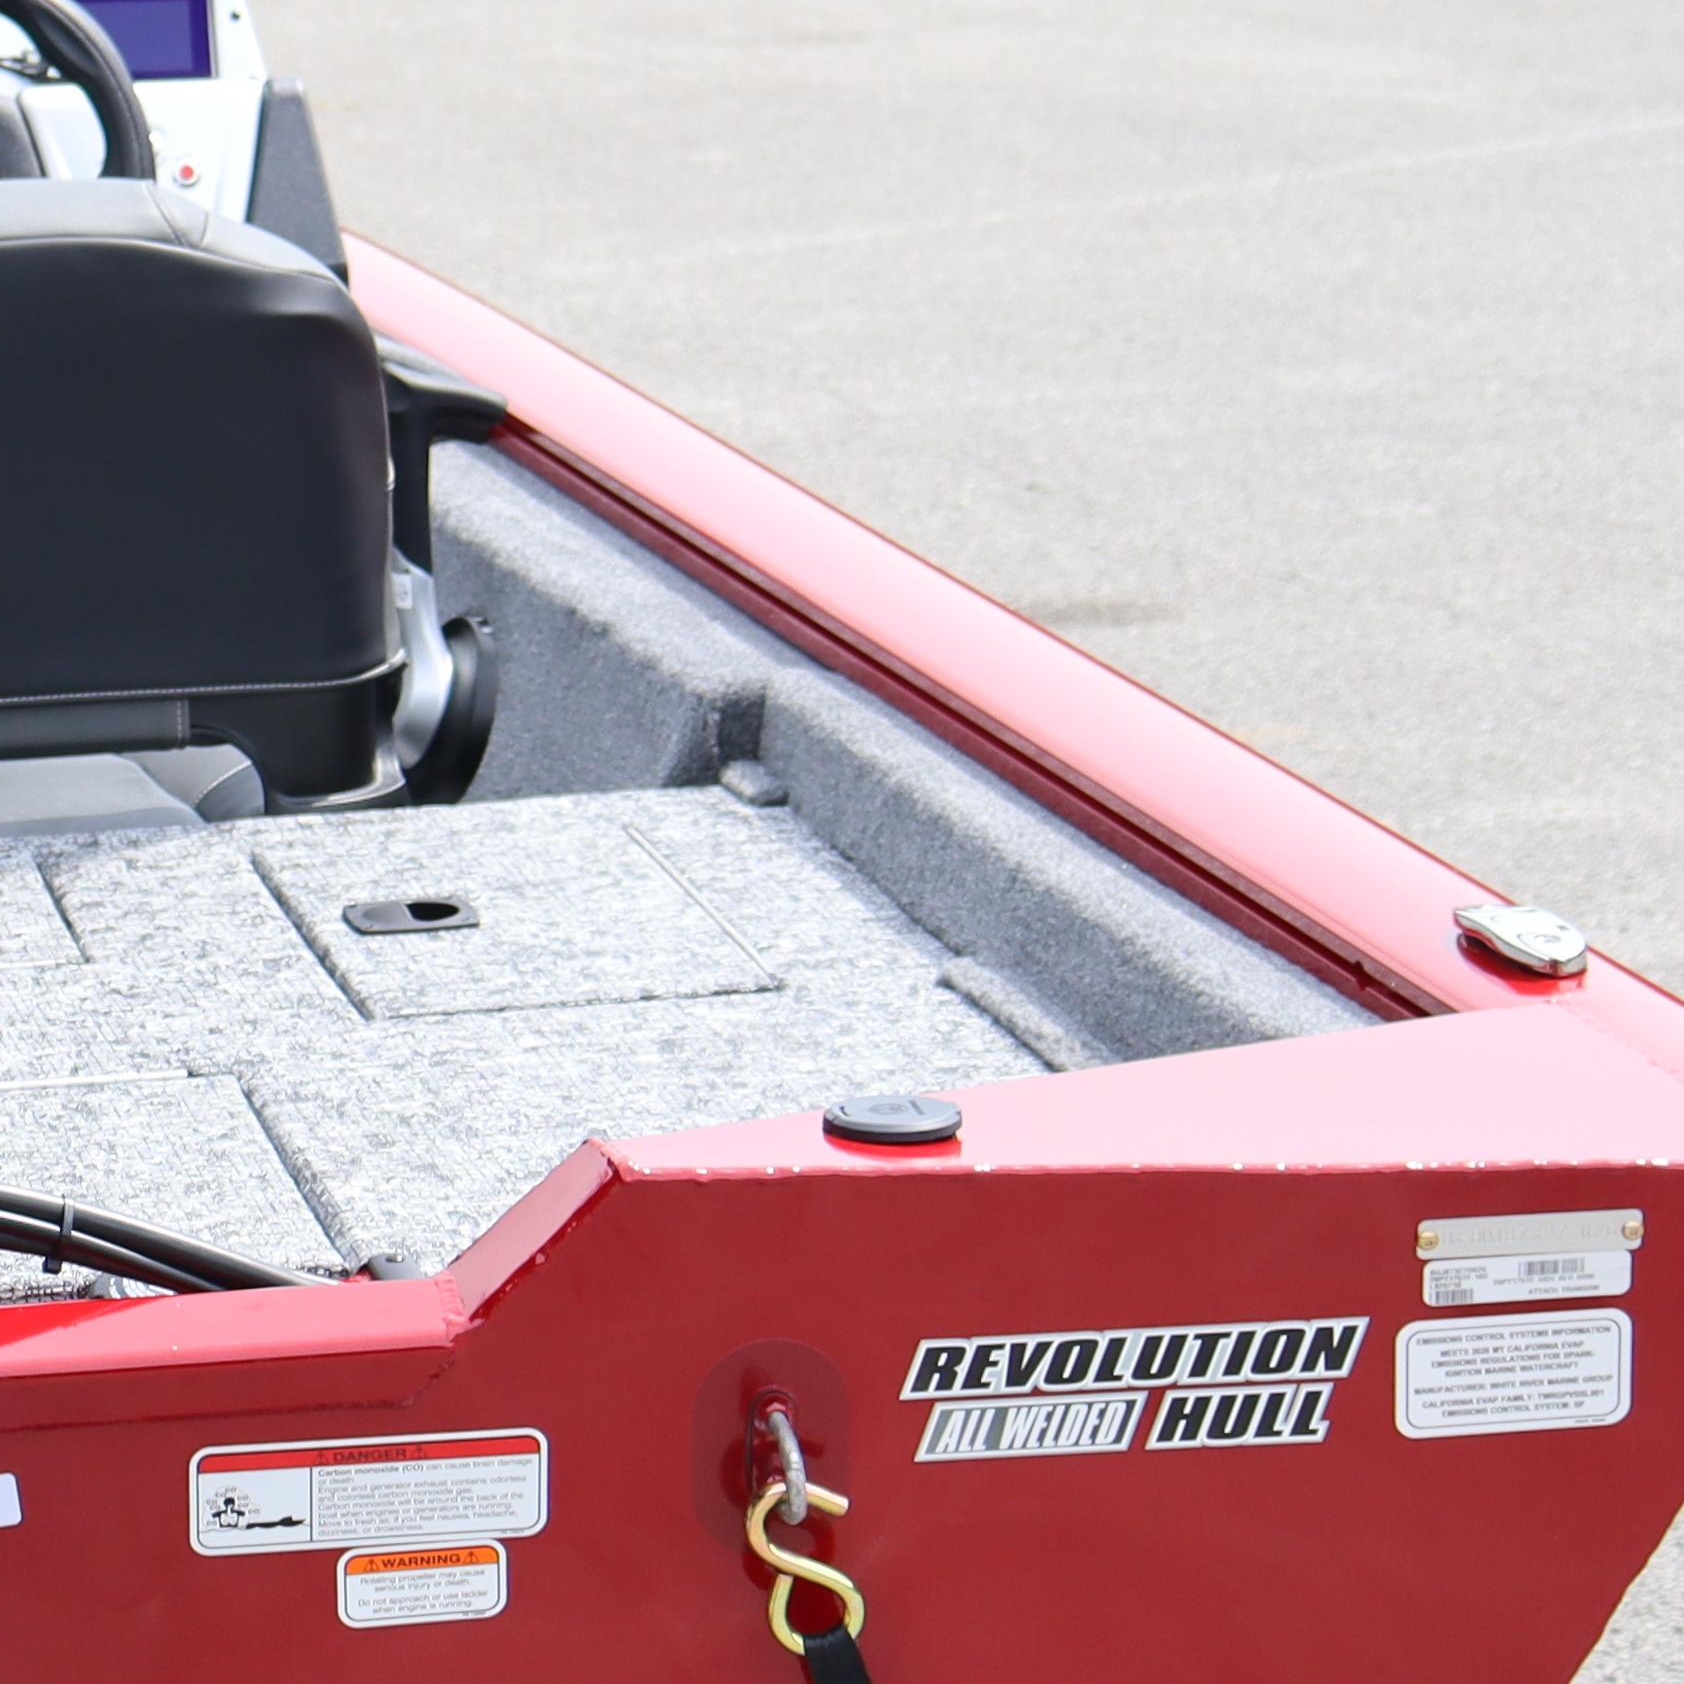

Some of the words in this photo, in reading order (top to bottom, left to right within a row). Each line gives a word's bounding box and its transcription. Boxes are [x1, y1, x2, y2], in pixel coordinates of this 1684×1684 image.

[1416, 1335, 1462, 1345] EMISSIONS
[1464, 1332, 1505, 1342] CONTROL
[1508, 1329, 1548, 1339] SYSTEMS
[1551, 1325, 1611, 1336] INFORMATION
[1440, 1348, 1469, 1357] MEETS
[1507, 1342, 1558, 1353] CALIFORNIA
[1561, 1340, 1584, 1349] EVAP
[908, 1324, 1359, 1393] REVOLUTION
[1431, 1358, 1477, 1368] EMISSIONS
[1479, 1353, 1540, 1365] REGULATIONS
[1543, 1352, 1560, 1360] FOR
[1445, 1367, 1481, 1377] IGNITION
[1484, 1365, 1517, 1375] MARINE
[1519, 1361, 1578, 1372] WATERCRAFT
[1489, 1380, 1516, 1390] WHITE
[1519, 1379, 1544, 1388] RIVER
[1547, 1376, 1579, 1386] MARINE
[1582, 1374, 1613, 1383] GROUP
[1422, 1397, 1473, 1408] CALIFORNIA
[1476, 1396, 1498, 1404] EVAP
[1441, 1407, 1487, 1417] EMISSIONS
[1490, 1404, 1531, 1414] CONTROL
[936, 1408, 992, 1454] ALL
[999, 1400, 1127, 1450] WELDED
[1154, 1389, 1324, 1443] HULL
[333, 1448, 407, 1462] DANGER
[317, 1467, 351, 1477] Carbon
[354, 1464, 399, 1475] monoxide
[401, 1463, 423, 1473] (CO)
[444, 1461, 470, 1469] cause
[472, 1458, 494, 1467] brain
[497, 1456, 532, 1467] damage
[318, 1485, 348, 1496] Engine
[350, 1483, 367, 1492] and
[369, 1481, 411, 1493] generator
[413, 1478, 447, 1488] exhaust
[450, 1475, 486, 1486] contains
[489, 1473, 526, 1484] odorless
[318, 1494, 334, 1503] and
[336, 1491, 374, 1502] colorless
[377, 1489, 408, 1499] carbon
[410, 1487, 453, 1497] monoxide
[318, 1502, 350, 1511] Carbon
[351, 1499, 395, 1510] monoxide
[397, 1498, 410, 1507] will
[413, 1497, 424, 1506] be
[427, 1495, 456, 1505] around
[459, 1494, 474, 1502] the
[476, 1492, 497, 1501] back
[499, 1491, 508, 1499] of
[510, 1490, 524, 1499] the
[318, 1511, 336, 1520] boat
[338, 1510, 362, 1519] when
[365, 1508, 399, 1519] engines
[412, 1503, 460, 1515] generators
[462, 1503, 475, 1511] are
[318, 1519, 341, 1528] Move
[354, 1517, 376, 1526] fresh
[401, 1515, 416, 1524] you
[418, 1513, 434, 1522] feel
[382, 1553, 461, 1569] WARNING
[359, 1575, 396, 1586] Rotating
[398, 1572, 436, 1583] propeller
[438, 1571, 457, 1580] may
[459, 1568, 485, 1576] cause
[374, 1583, 405, 1592] serious
[407, 1580, 430, 1591] injury
[358, 1598, 369, 1607] Do
[372, 1597, 387, 1605] not
[388, 1593, 430, 1605] approach
[460, 1588, 488, 1598] ladder
[372, 1605, 395, 1614] when
[398, 1603, 427, 1613] engine
